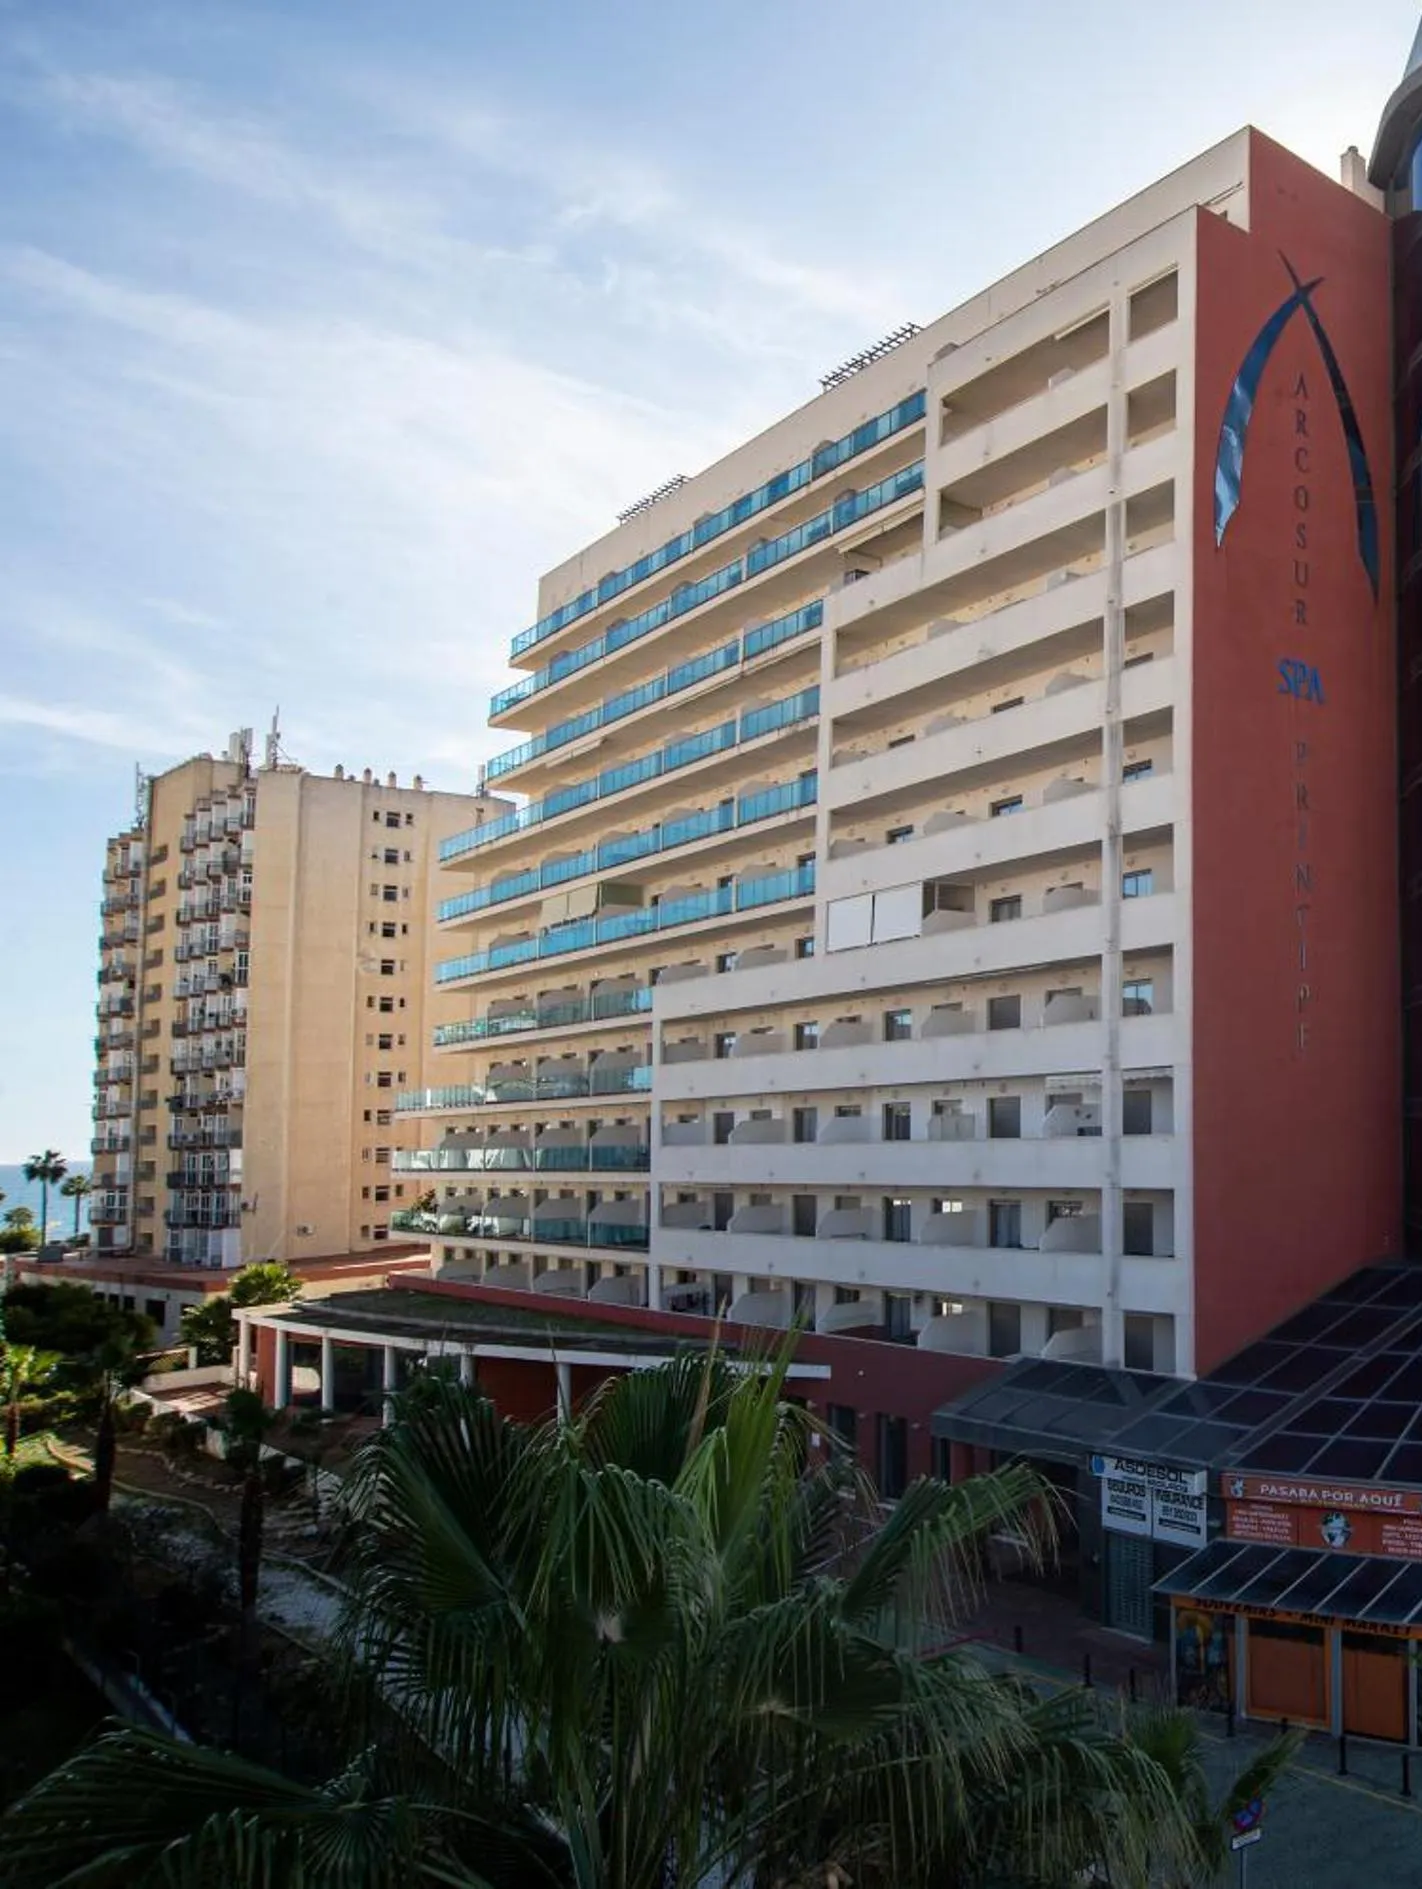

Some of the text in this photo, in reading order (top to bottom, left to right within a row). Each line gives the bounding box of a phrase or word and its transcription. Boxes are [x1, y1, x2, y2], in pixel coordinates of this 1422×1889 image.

[1293, 372, 1309, 626] ARCOSUR
[1276, 659, 1325, 705] SPA
[1260, 1484, 1319, 1499] PASABA
[1321, 1489, 1353, 1503] POR
